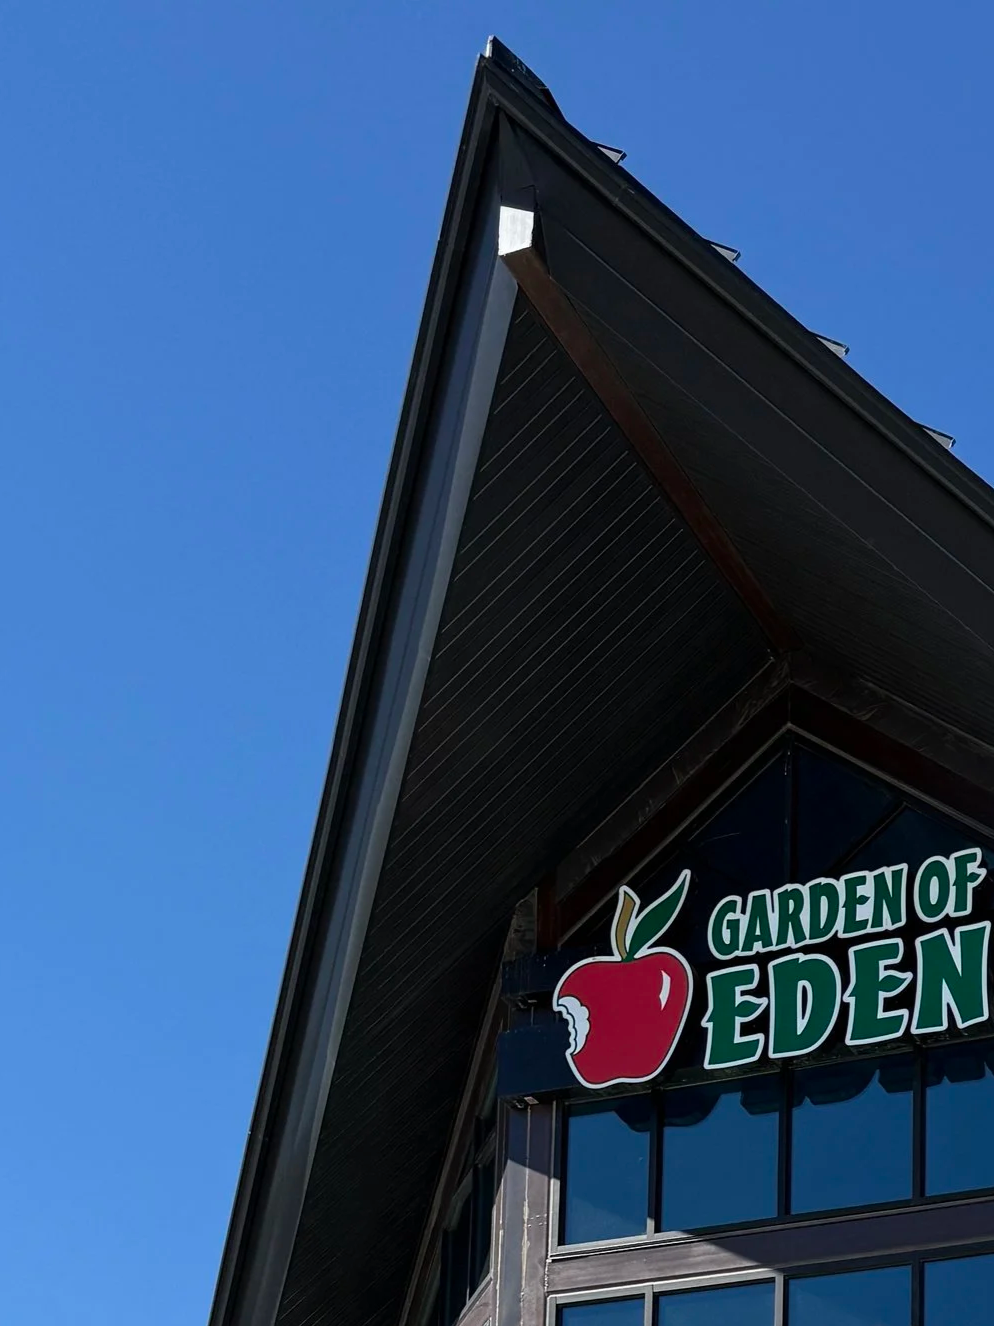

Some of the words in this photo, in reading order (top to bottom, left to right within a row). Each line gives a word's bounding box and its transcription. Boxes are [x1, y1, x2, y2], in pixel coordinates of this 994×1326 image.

[708, 863, 907, 959] GARDEN
[913, 848, 986, 922] OF
[702, 921, 991, 1069] EDEN
